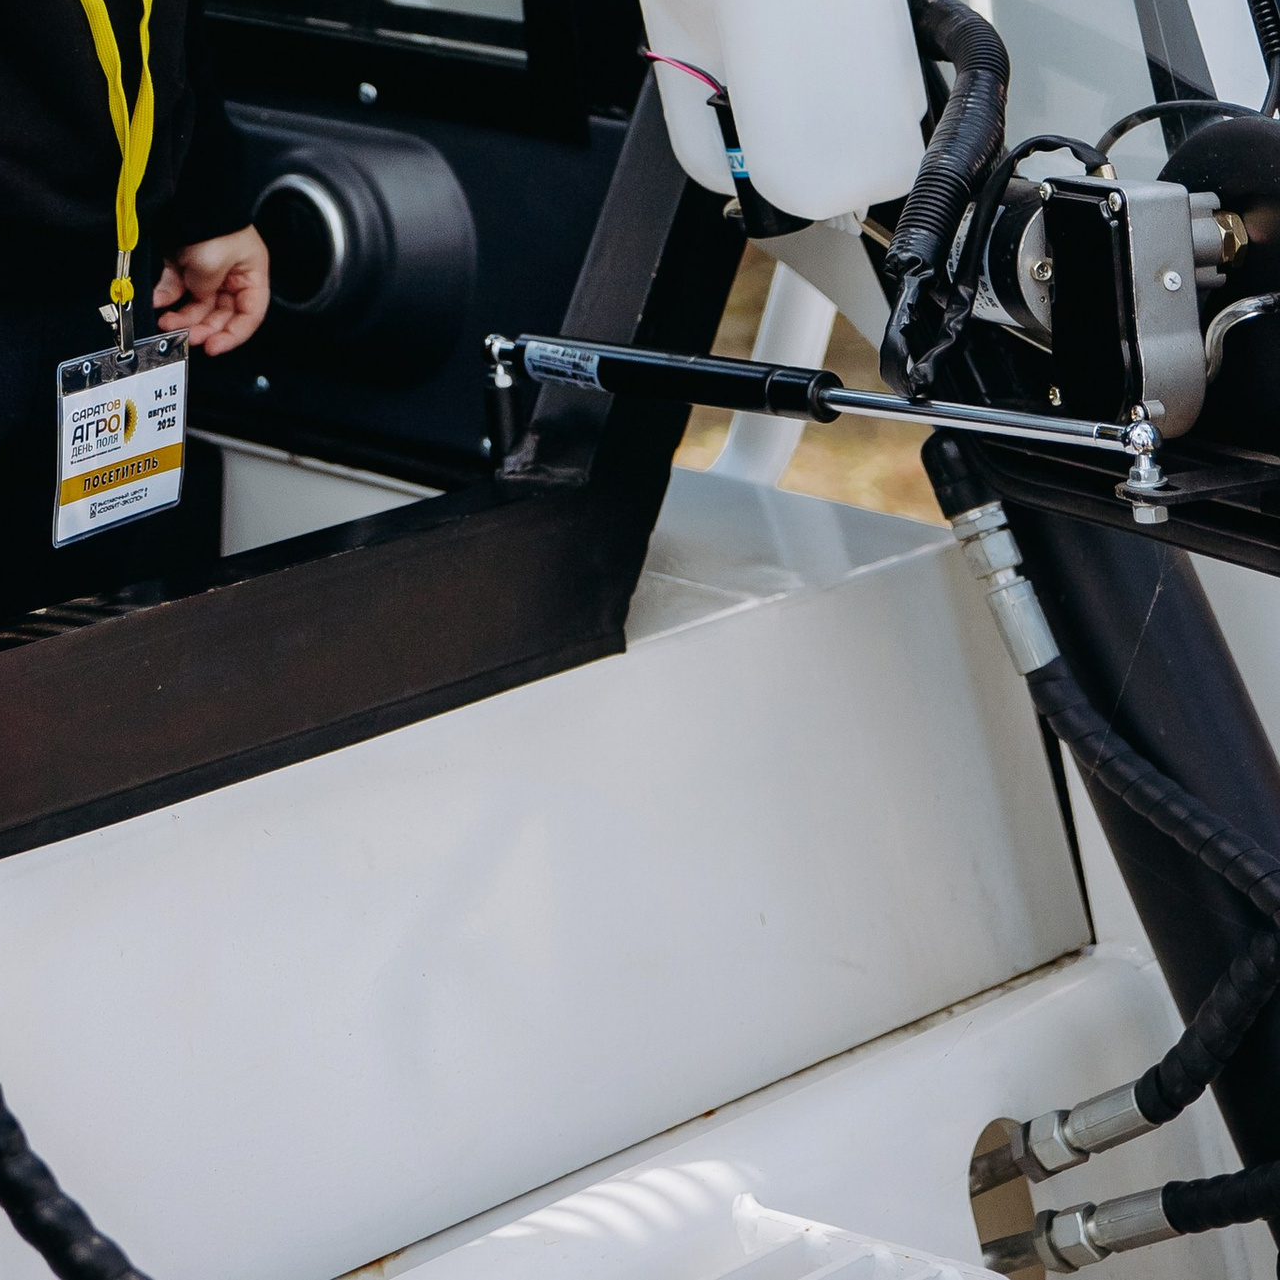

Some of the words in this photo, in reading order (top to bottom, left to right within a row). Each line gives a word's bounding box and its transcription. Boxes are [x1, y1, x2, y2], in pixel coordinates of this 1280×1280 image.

[154, 388, 163, 401] 14
[169, 384, 178, 397] 15
[72, 398, 121, 423] САРАТОВ
[147, 402, 177, 419] августа
[156, 415, 176, 432] 2025
[71, 441, 94, 459] ДЕНЬ
[96, 433, 119, 449] ПОЛЯ
[83, 456, 159, 492] ПОСЕТИТЕЛЬ
